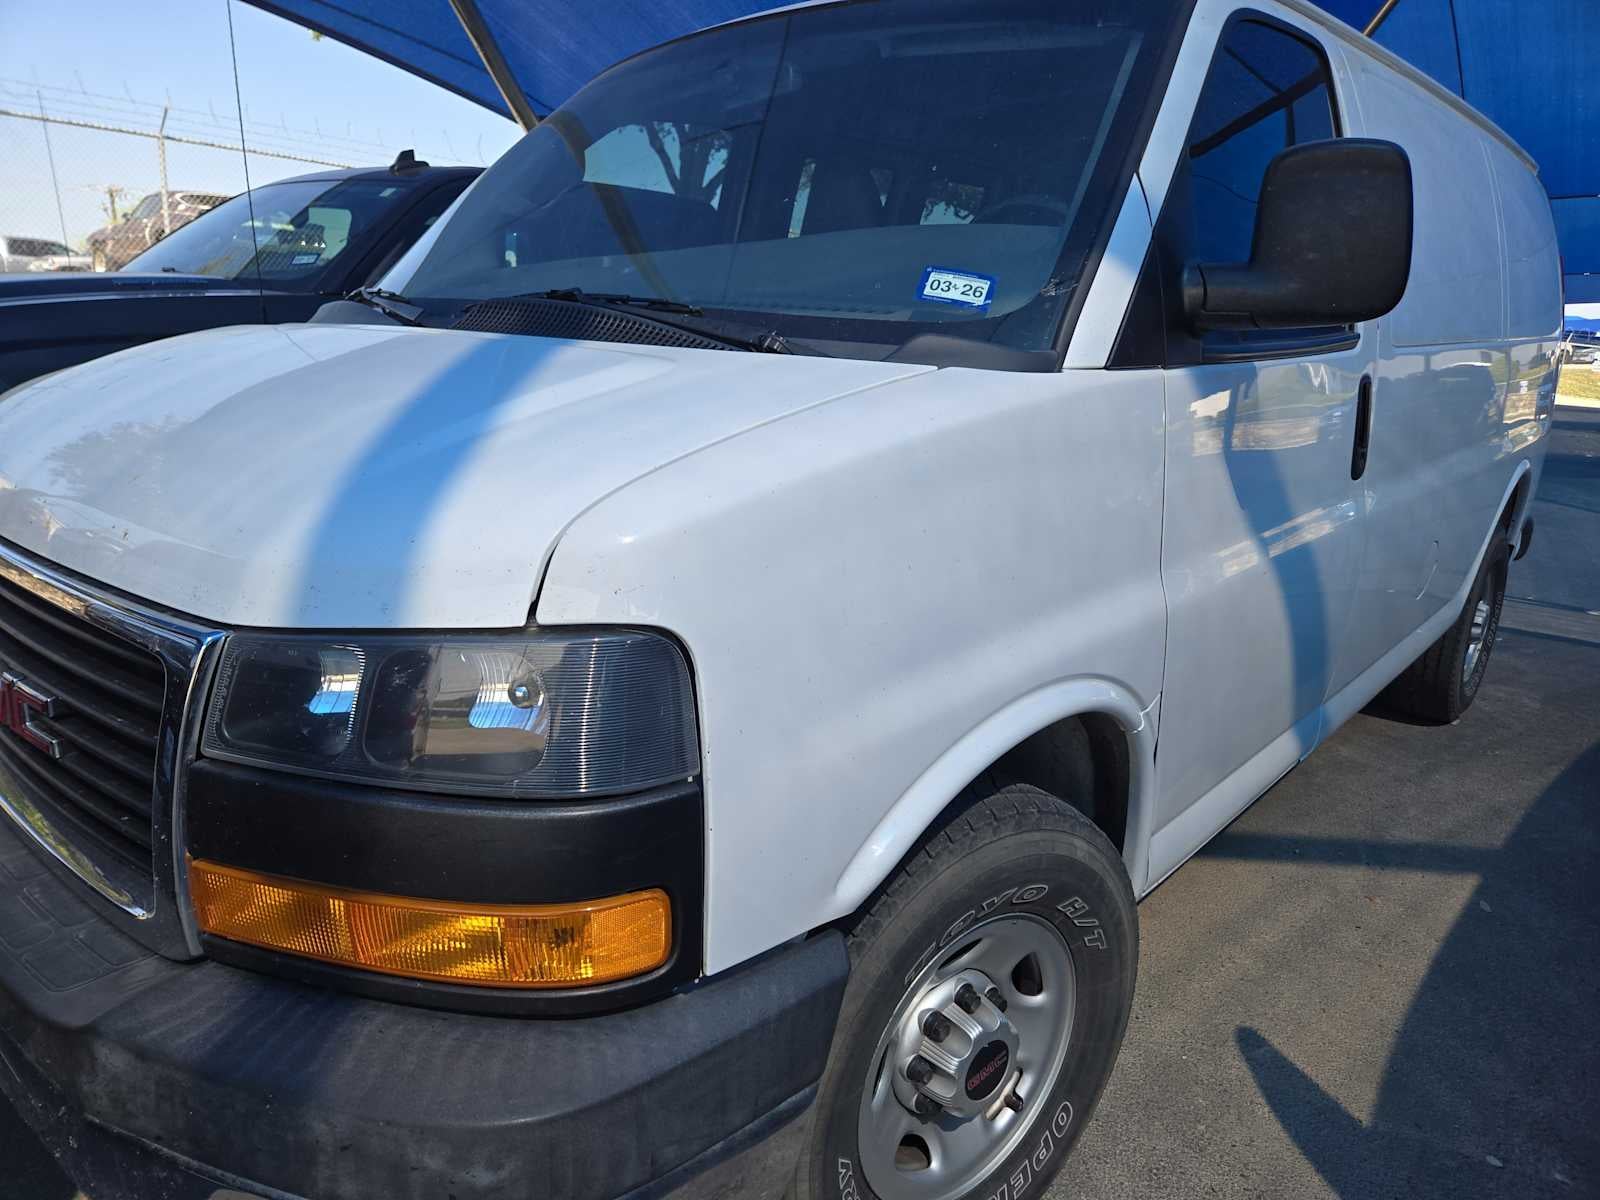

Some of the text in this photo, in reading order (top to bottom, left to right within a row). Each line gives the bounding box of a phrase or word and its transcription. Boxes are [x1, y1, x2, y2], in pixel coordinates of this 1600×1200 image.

[929, 279, 985, 298] 03 26
[1056, 896, 1107, 951] H/T
[967, 1049, 1008, 1091] GMC
